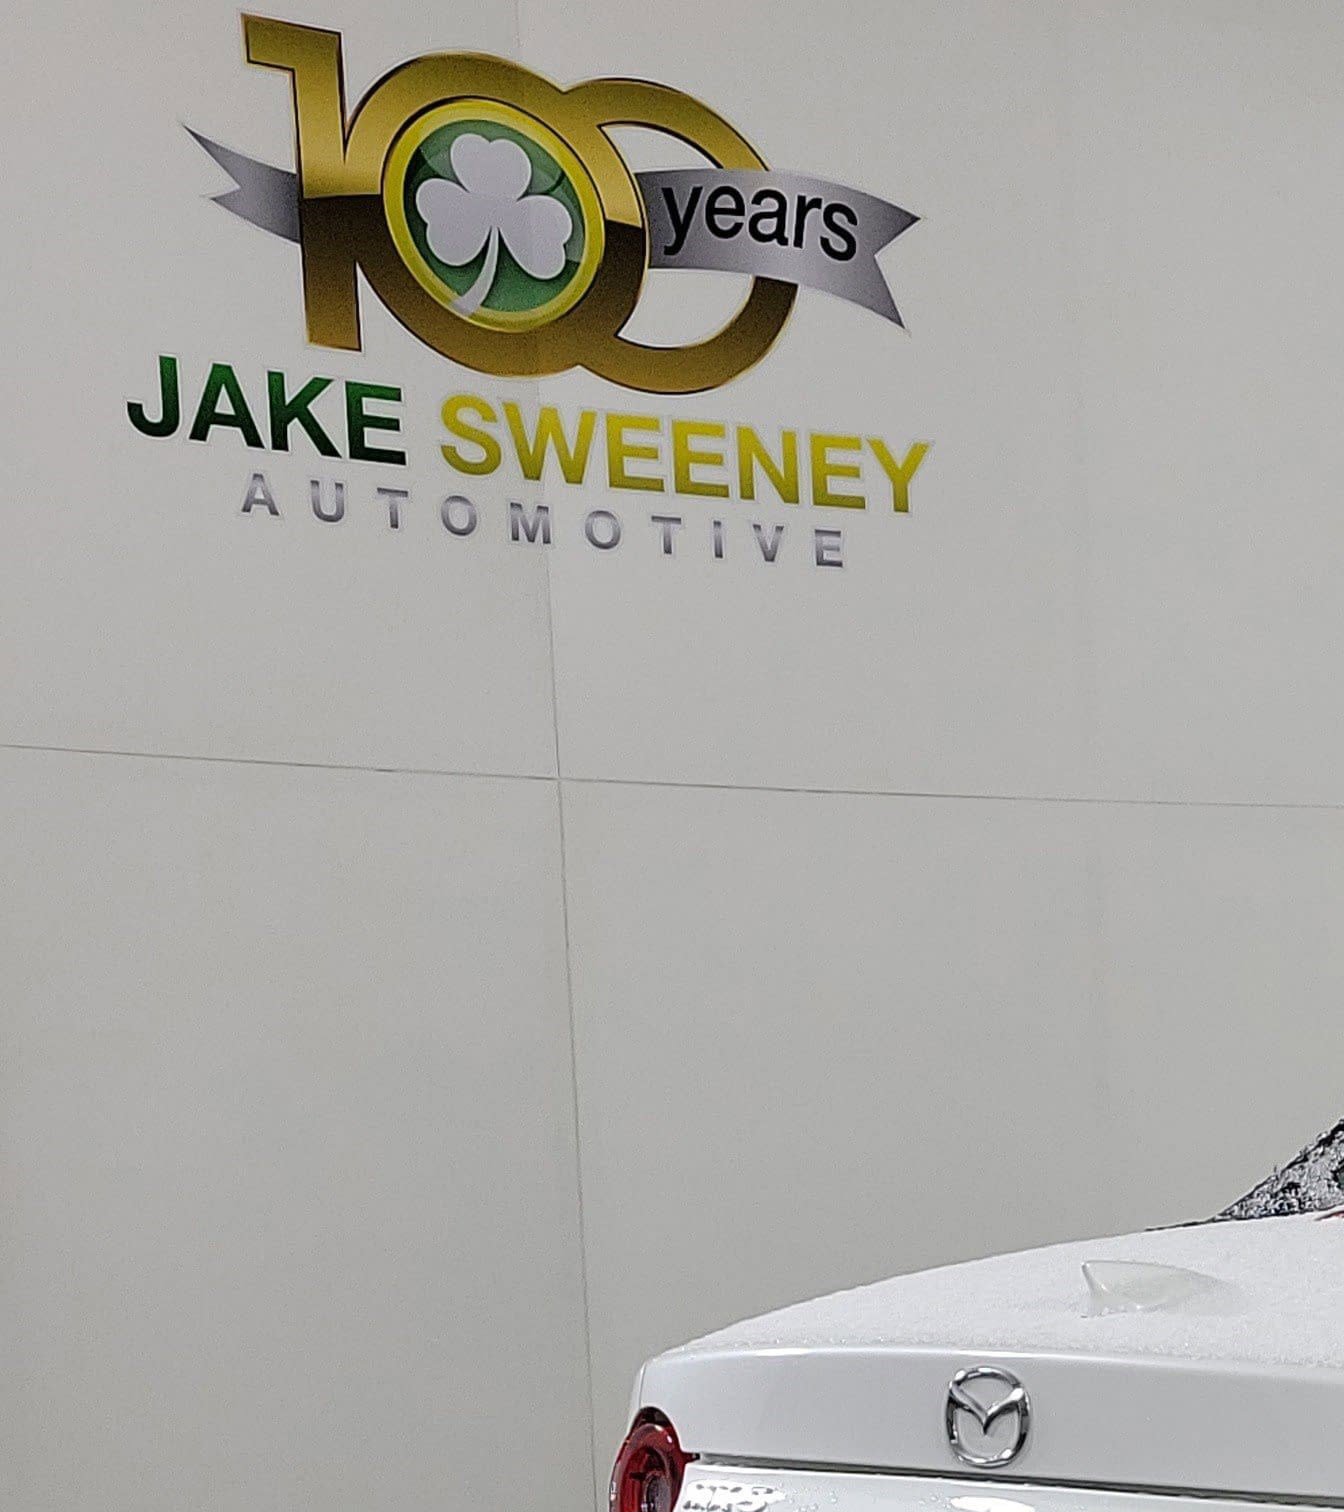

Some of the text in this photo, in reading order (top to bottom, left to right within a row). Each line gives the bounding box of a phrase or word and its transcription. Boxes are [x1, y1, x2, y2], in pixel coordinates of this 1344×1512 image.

[243, 13, 859, 395] 100 years
[126, 356, 931, 514] JAKE SWEENEY
[241, 473, 844, 569] AUTOMOTIVE
